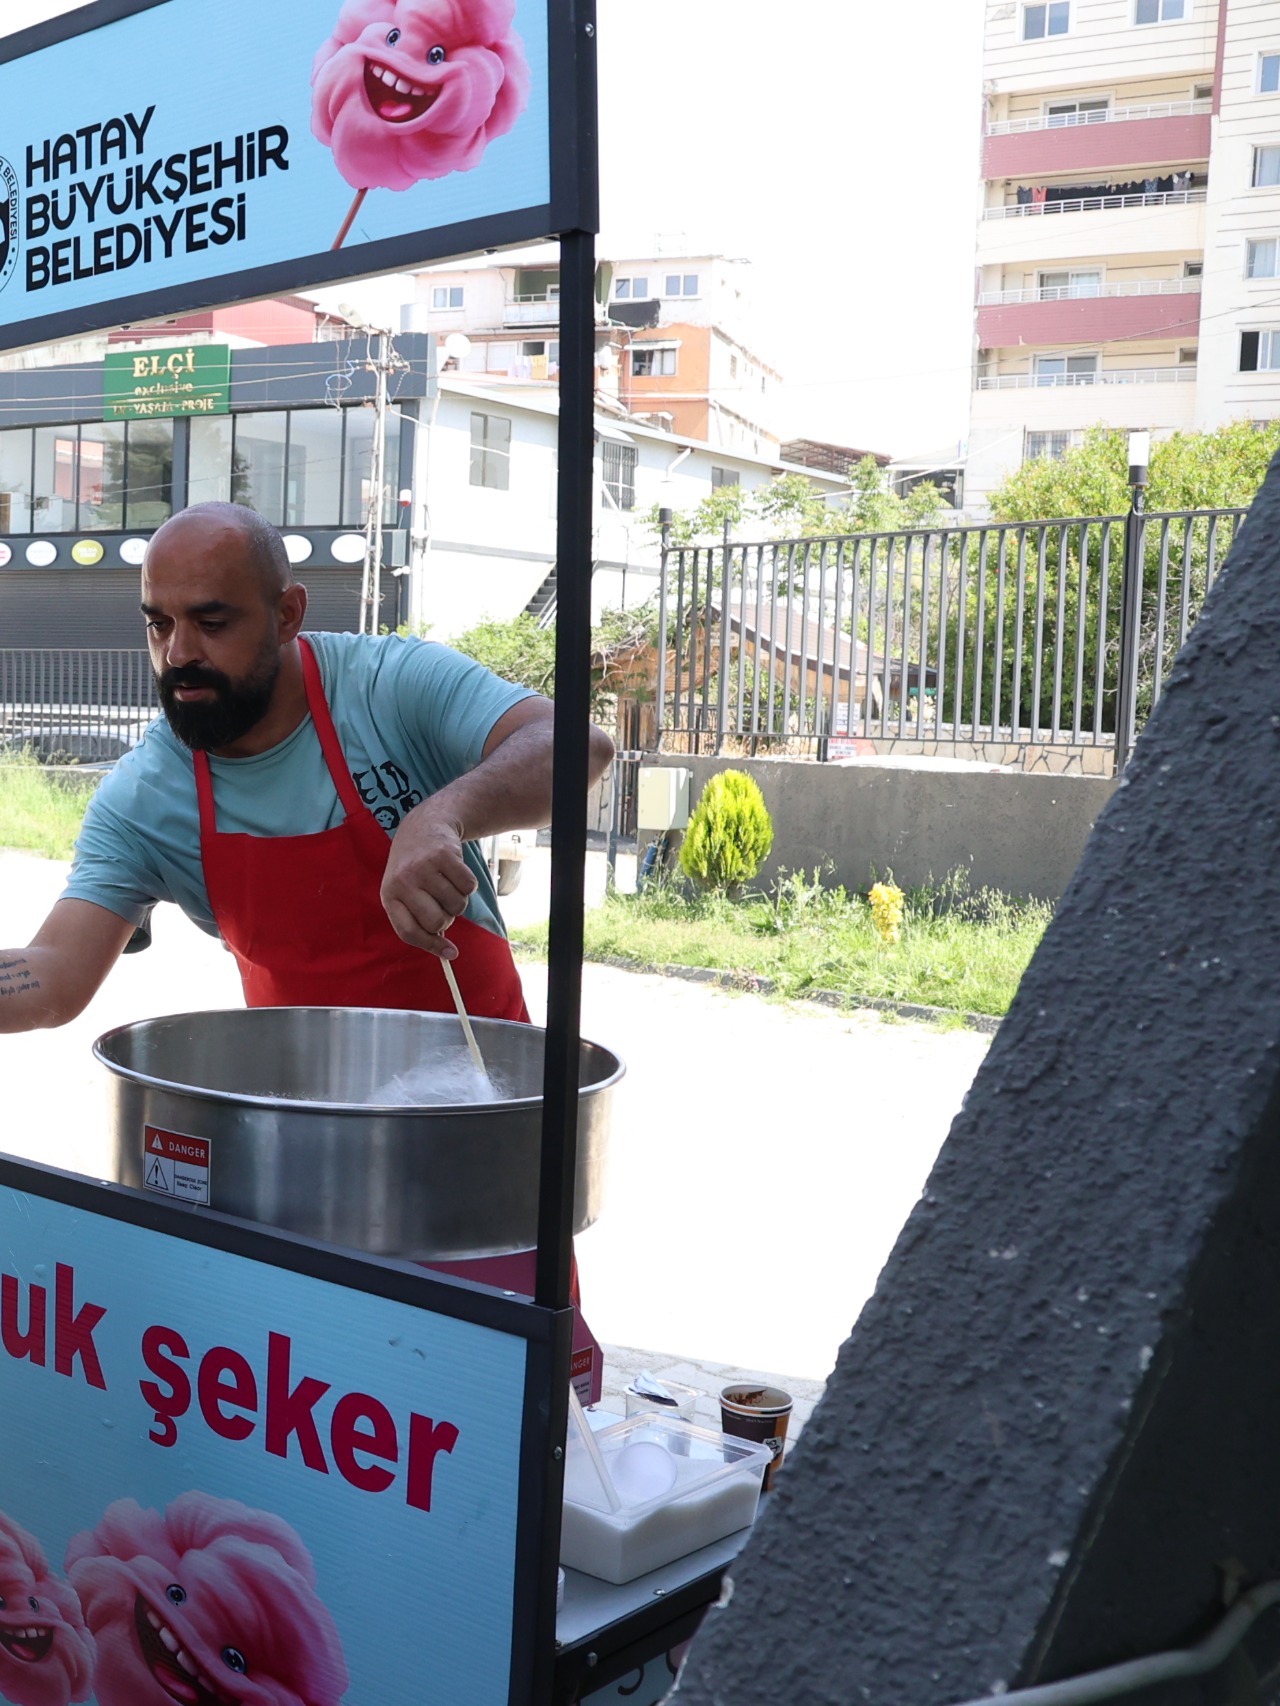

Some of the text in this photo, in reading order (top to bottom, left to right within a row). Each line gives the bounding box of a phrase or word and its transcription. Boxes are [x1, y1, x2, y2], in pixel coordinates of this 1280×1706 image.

[25, 105, 157, 188] HATAY
[26, 125, 289, 240] BÜYÜKŞEHİR
[26, 193, 246, 292] BELEDİYESİ
[133, 348, 195, 379] ELÇİ
[134, 381, 194, 396] exclusive
[181, 398, 214, 411] PROJE
[169, 1142, 205, 1158] DANGER
[571, 1357, 590, 1370] NGER
[139, 1325, 460, 1513] şeker
